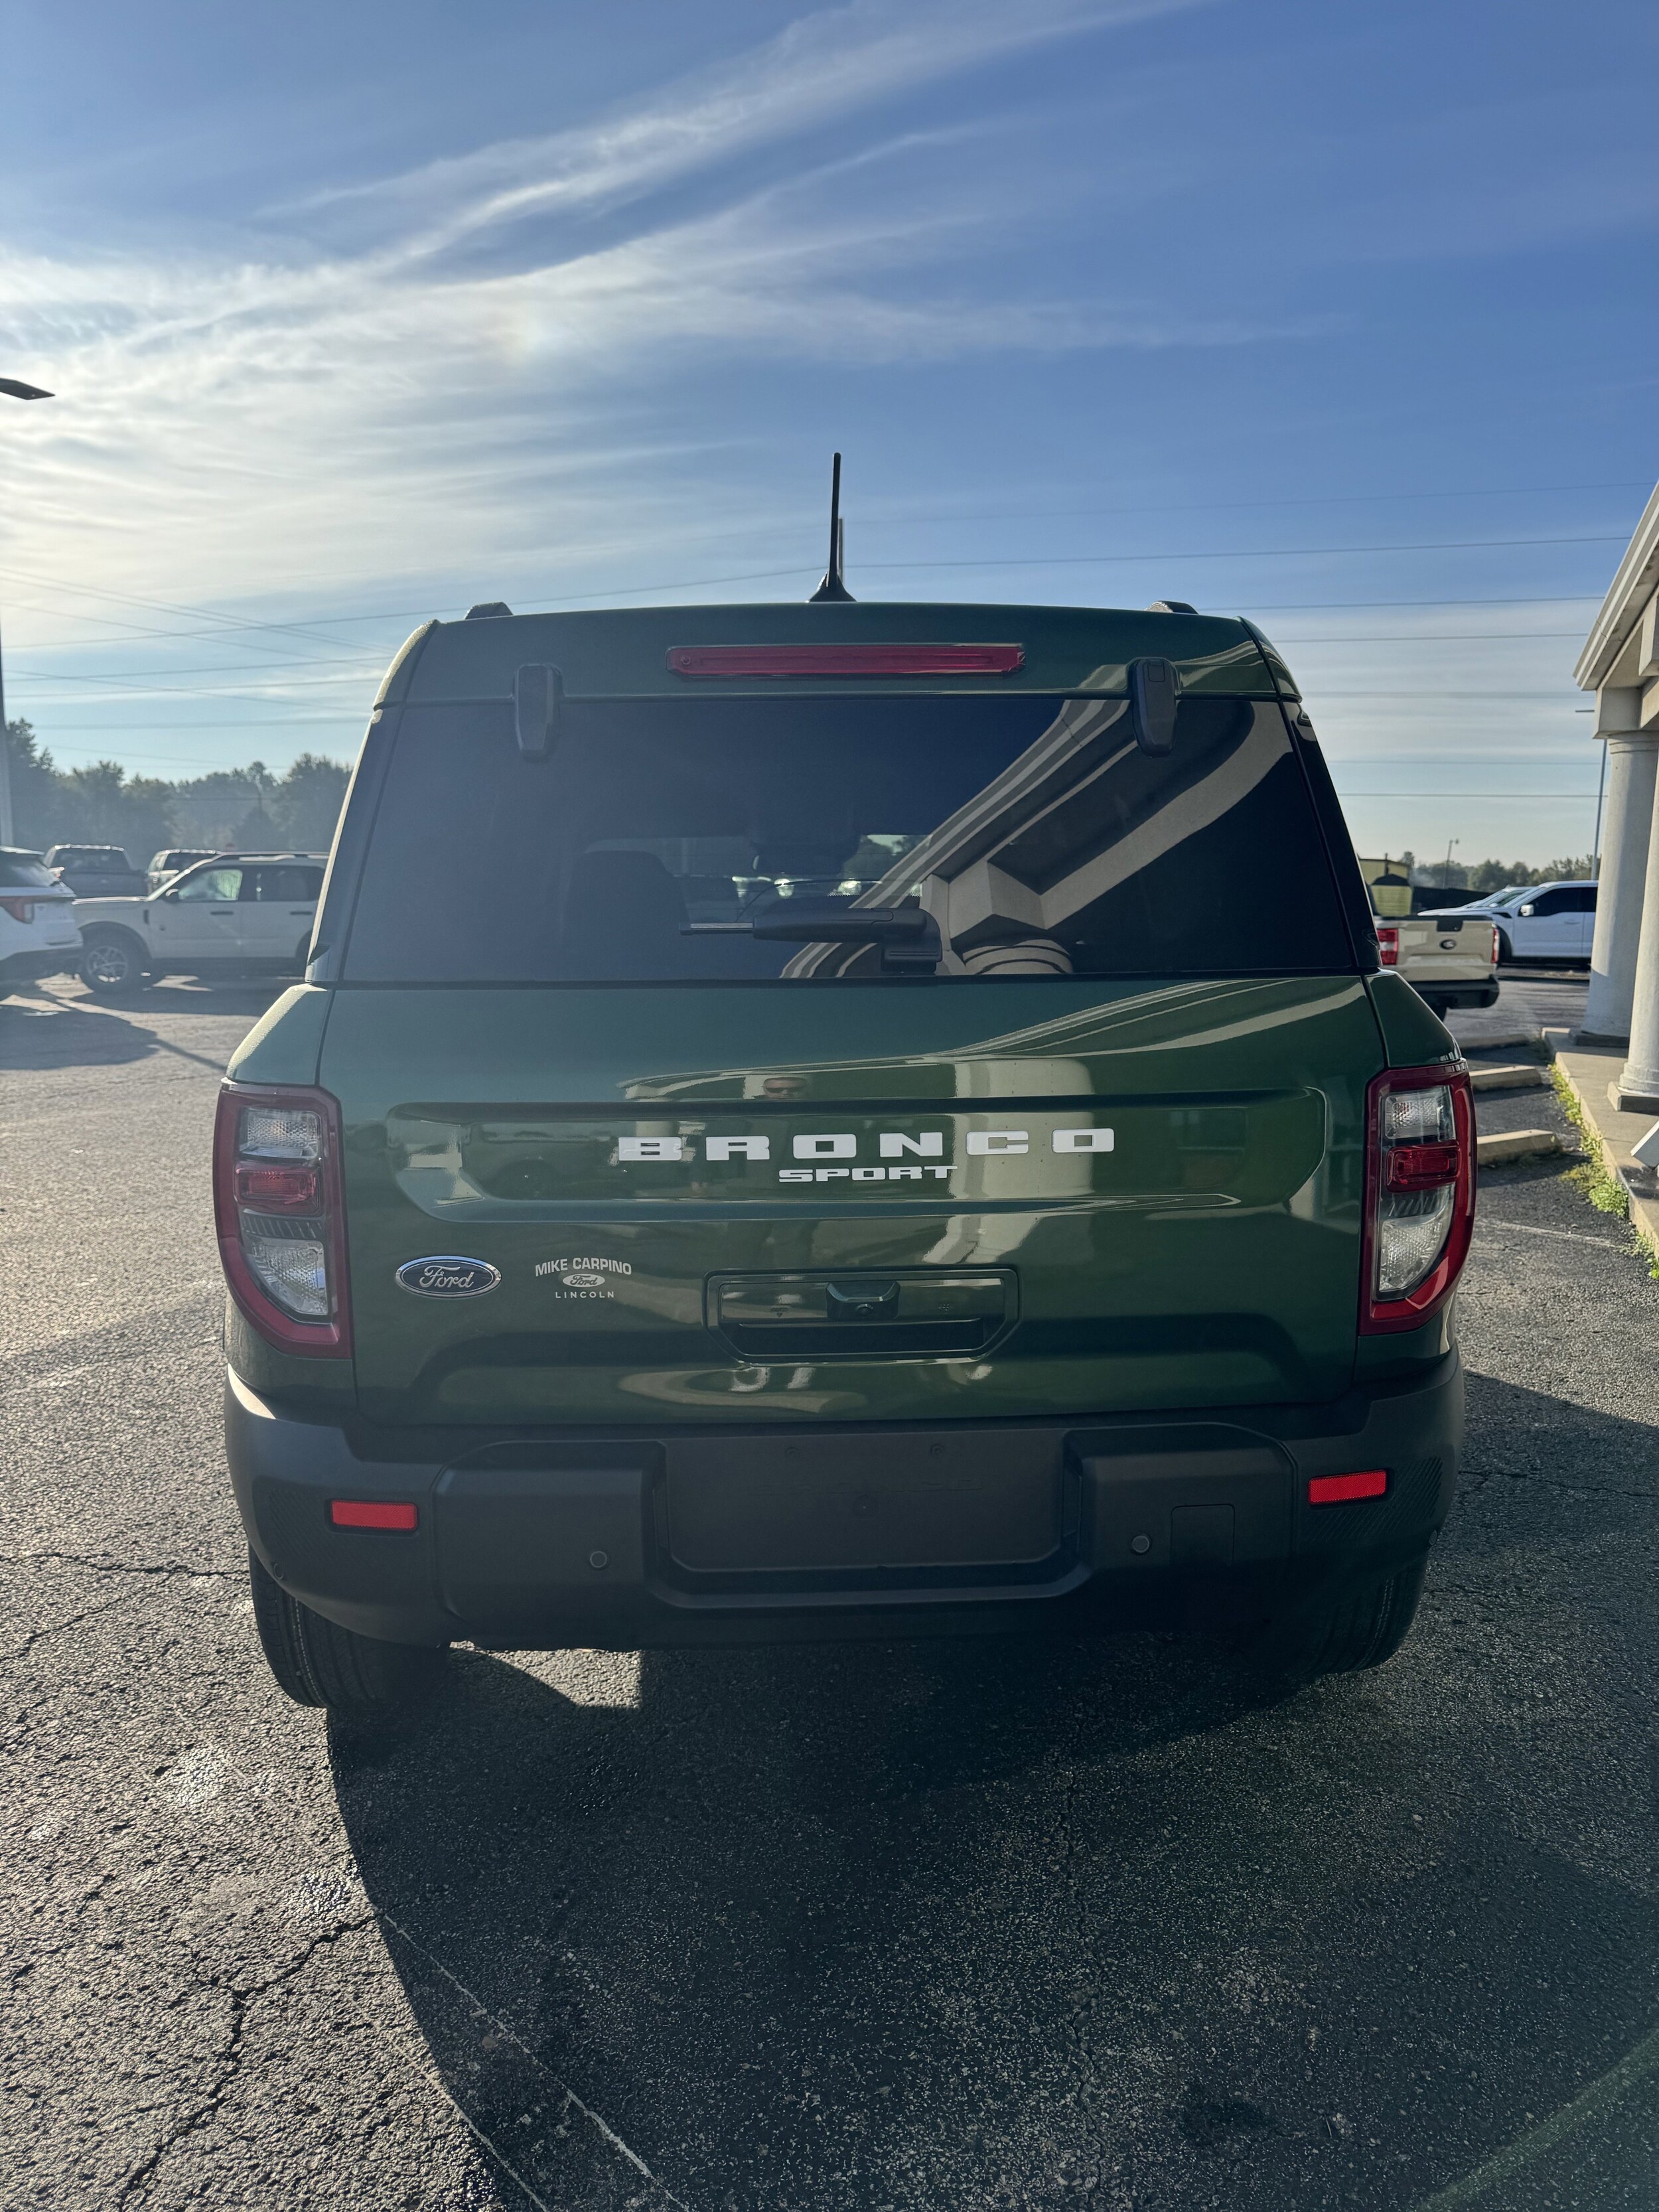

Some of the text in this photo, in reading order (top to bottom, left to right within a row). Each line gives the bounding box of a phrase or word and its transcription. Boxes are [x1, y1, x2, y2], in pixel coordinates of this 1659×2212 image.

[618, 1128, 1114, 1161] BRONCO
[778, 1165, 958, 1183] SPORT
[419, 1265, 474, 1289] Ford
[535, 1257, 632, 1277] MIKE CARPINO
[569, 1275, 598, 1286] Ford
